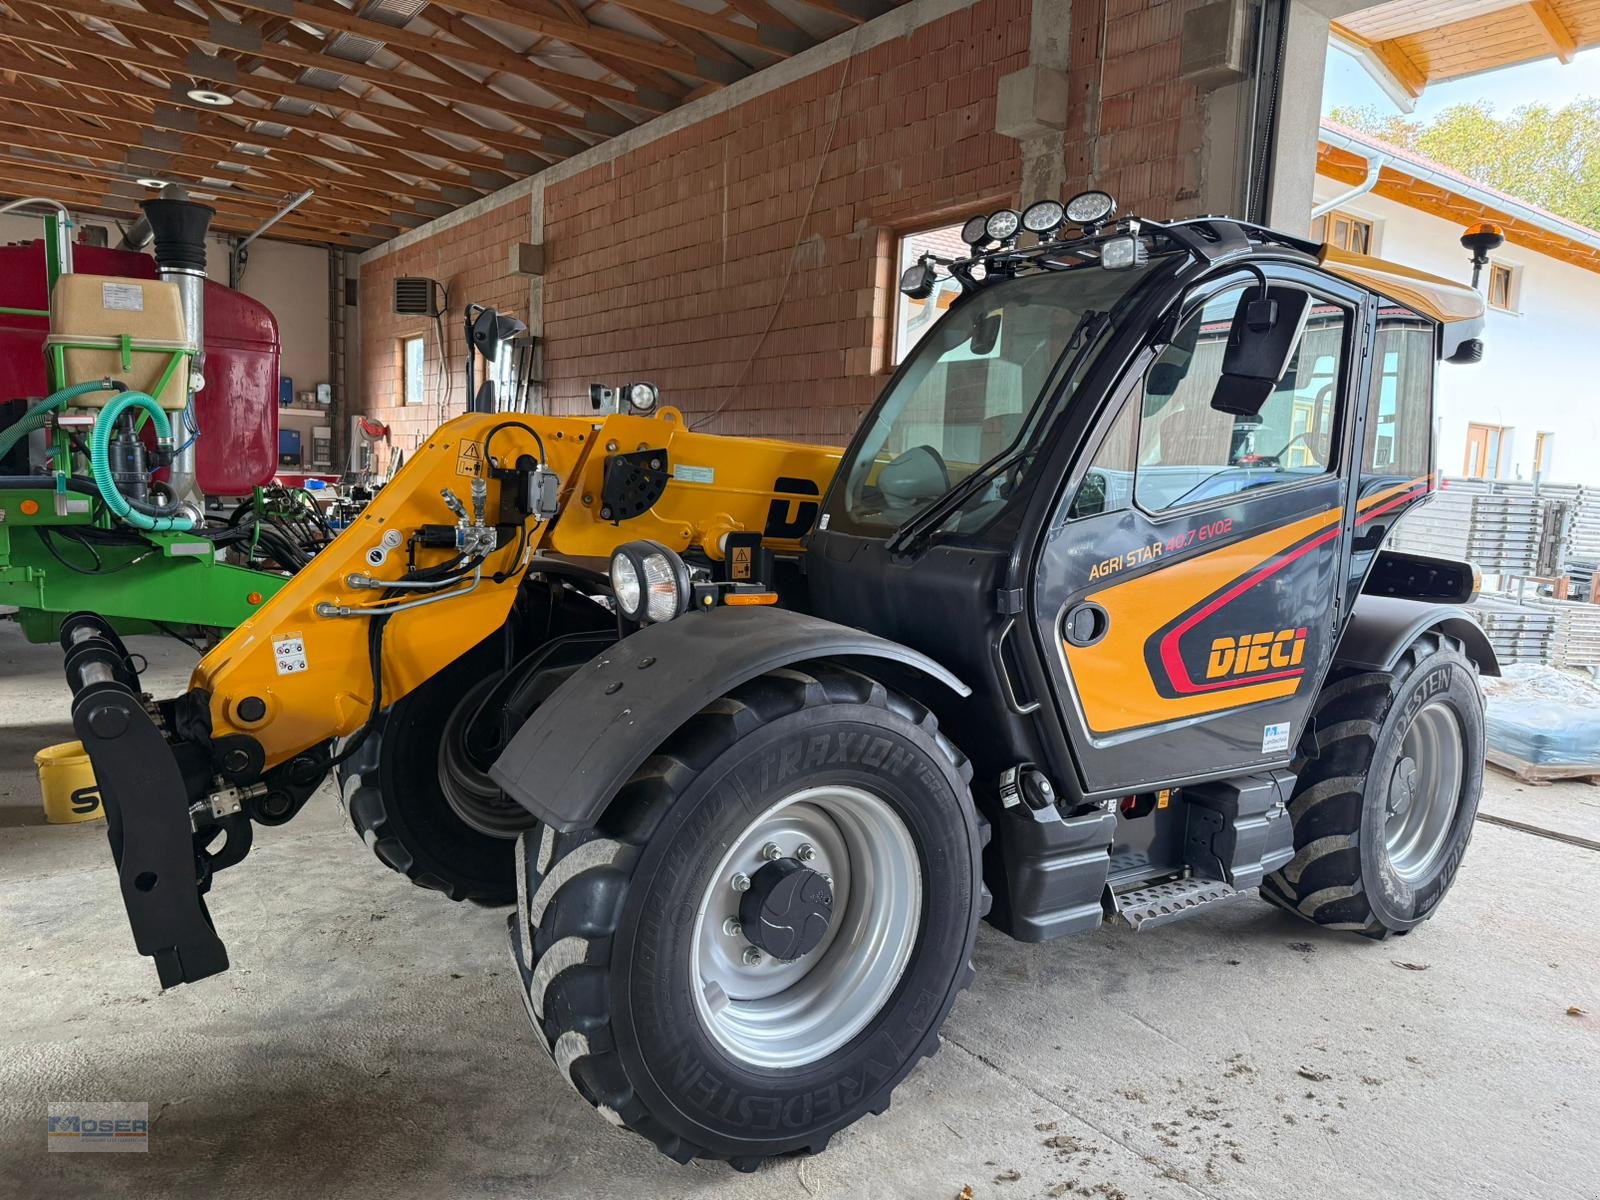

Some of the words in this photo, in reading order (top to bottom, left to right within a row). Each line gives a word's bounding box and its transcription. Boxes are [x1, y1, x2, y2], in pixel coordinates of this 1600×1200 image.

[1088, 554, 1124, 582] AGRI
[1126, 541, 1163, 568] STAR
[1165, 529, 1197, 552] 40.7
[1198, 517, 1233, 541] EVO2
[1206, 627, 1308, 679] DIECI
[759, 731, 914, 792] TRAXION
[665, 1042, 895, 1132] VREDESTEIN
